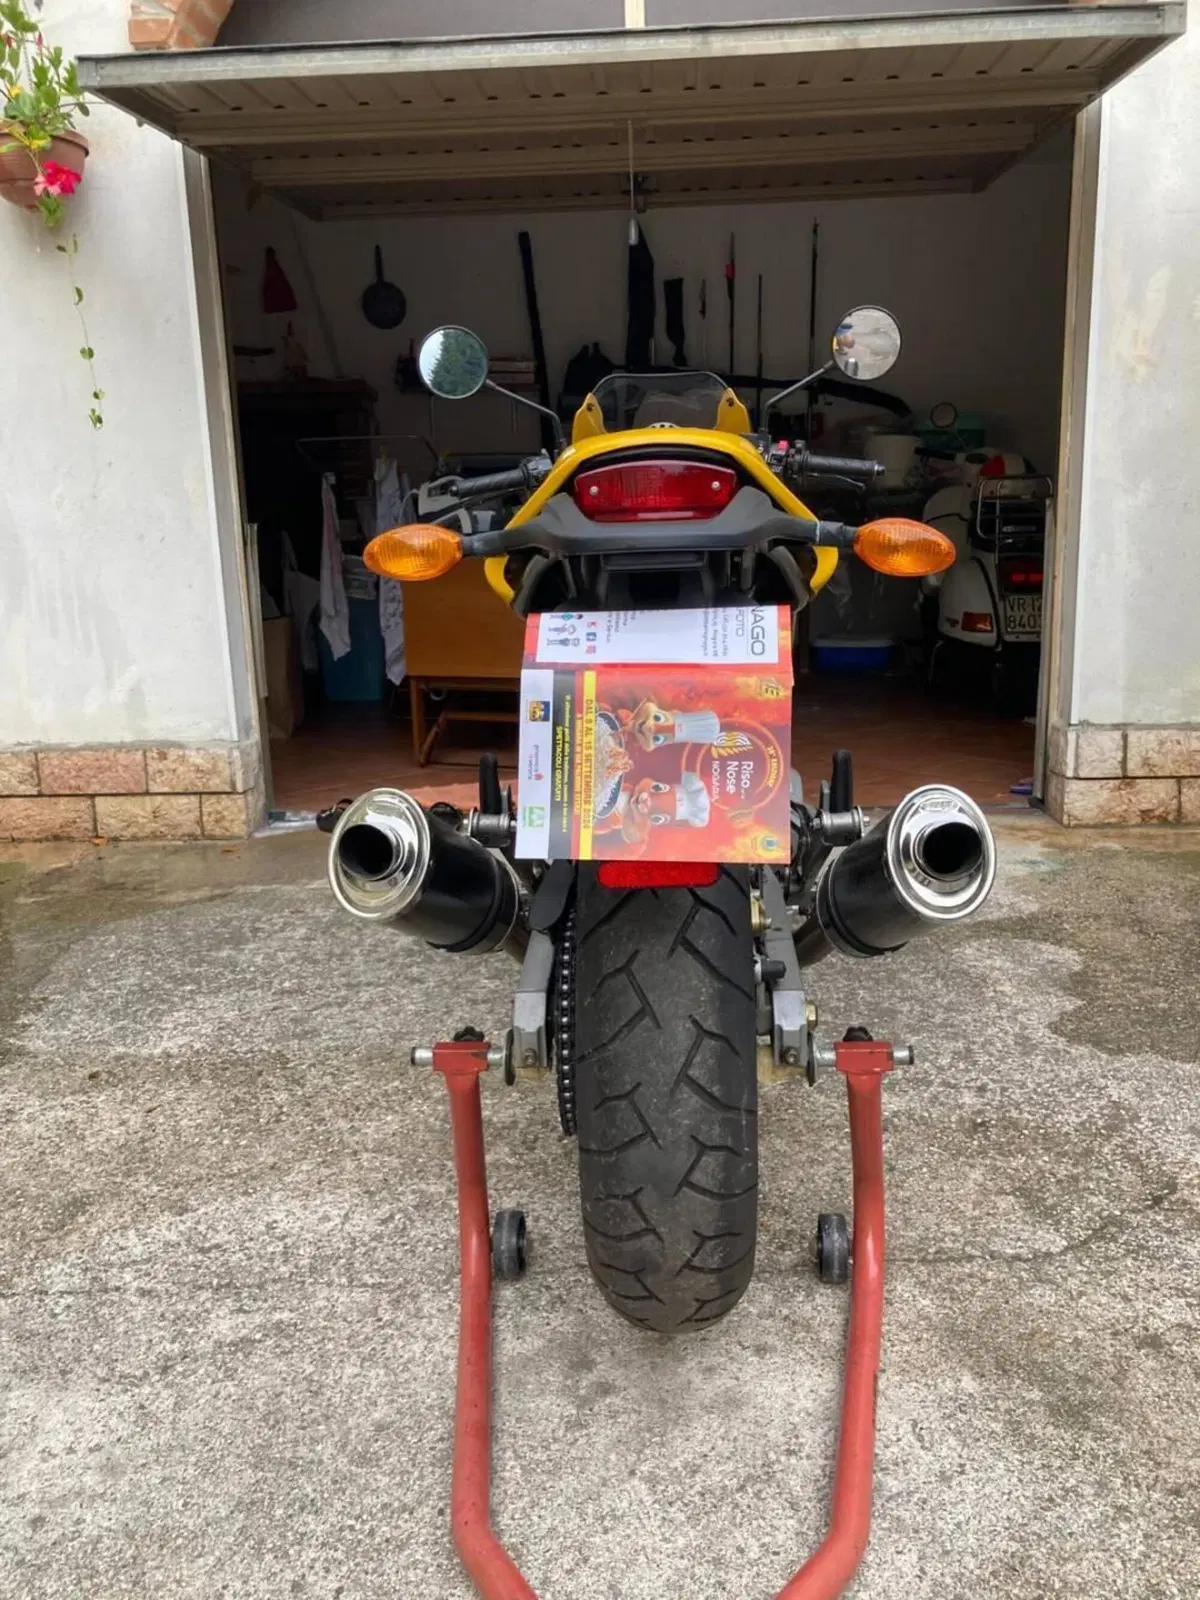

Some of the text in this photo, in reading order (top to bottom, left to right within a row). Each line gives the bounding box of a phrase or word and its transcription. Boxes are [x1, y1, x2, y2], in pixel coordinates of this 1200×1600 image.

[1008, 614, 1041, 629] 840
[586, 699, 594, 715] DAL
[585, 726, 593, 737] AL
[554, 726, 563, 801] SPETTACOLI GRATUITI
[584, 752, 592, 806] SETTEMBRE
[726, 761, 739, 794] Nose
